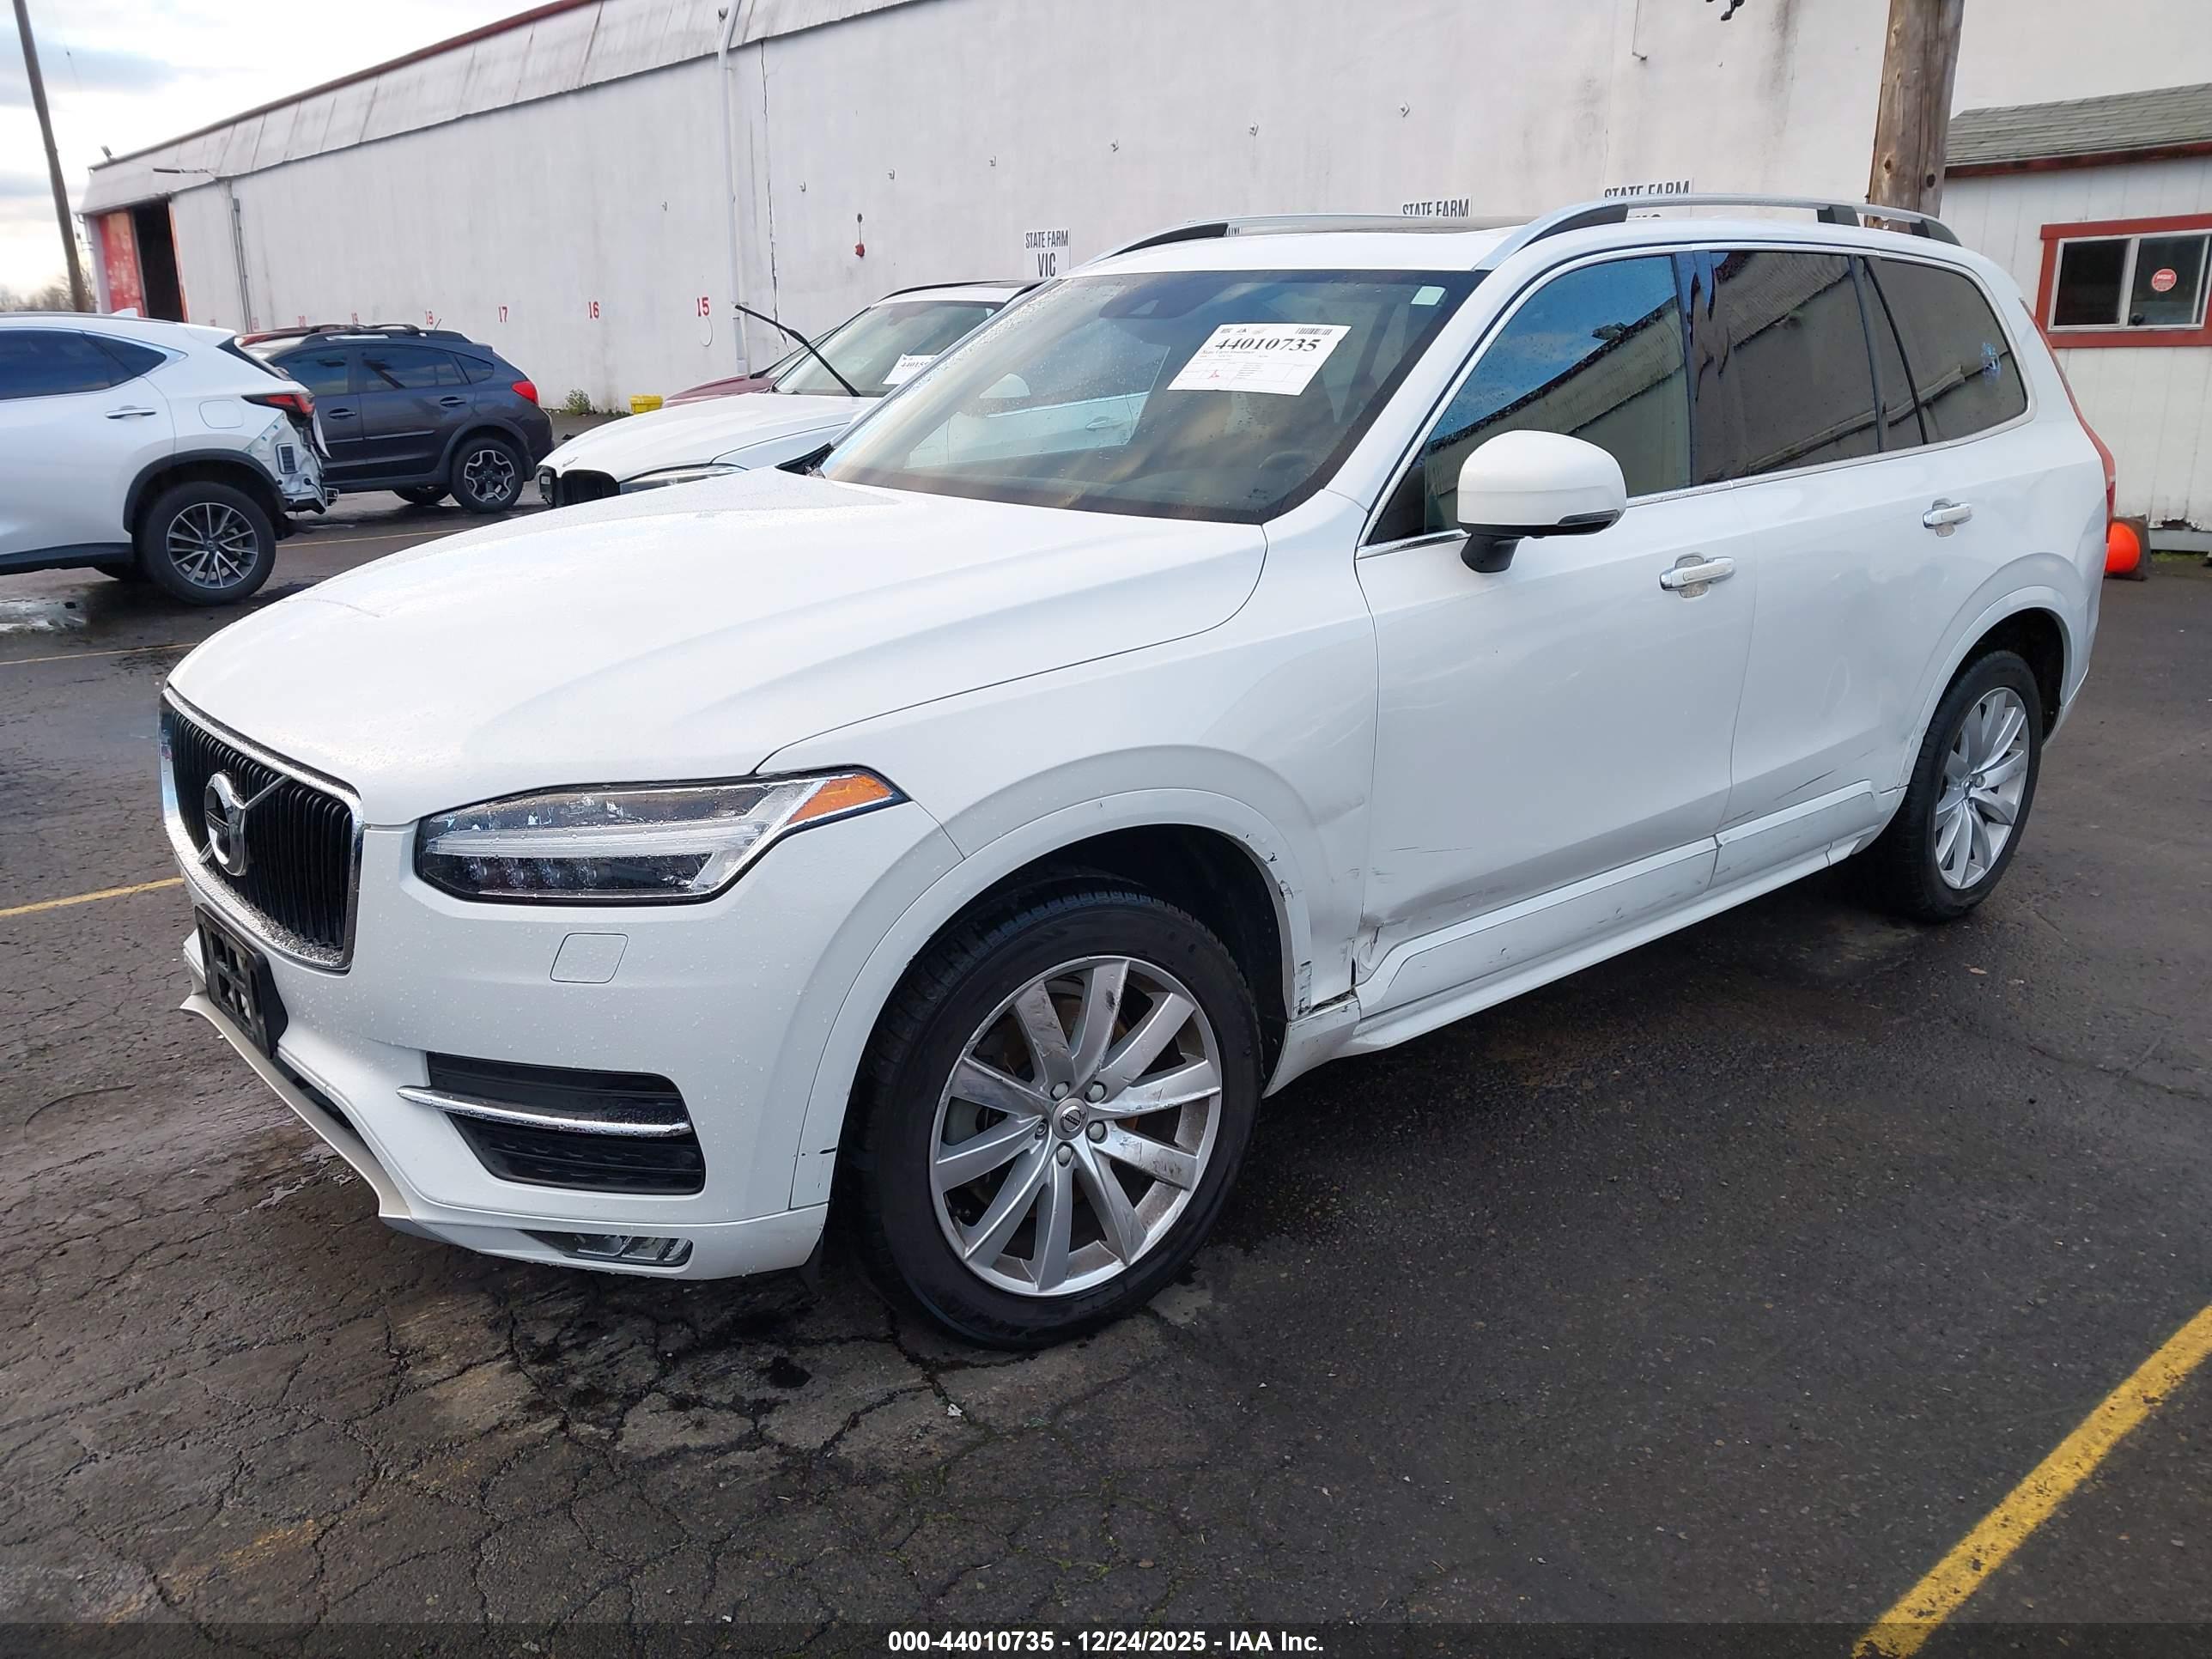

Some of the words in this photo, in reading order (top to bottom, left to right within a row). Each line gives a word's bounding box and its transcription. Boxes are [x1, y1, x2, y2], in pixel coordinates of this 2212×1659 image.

[1401, 201, 1433, 216] STATE
[1436, 198, 1469, 218] FARM
[1025, 231, 1046, 249] STATE
[1047, 229, 1069, 248] FARM
[1037, 252, 1056, 277] VIC
[498, 306, 508, 323] 17
[587, 301, 600, 319] 16
[696, 296, 710, 317] 15
[1215, 337, 1322, 352] 44010735
